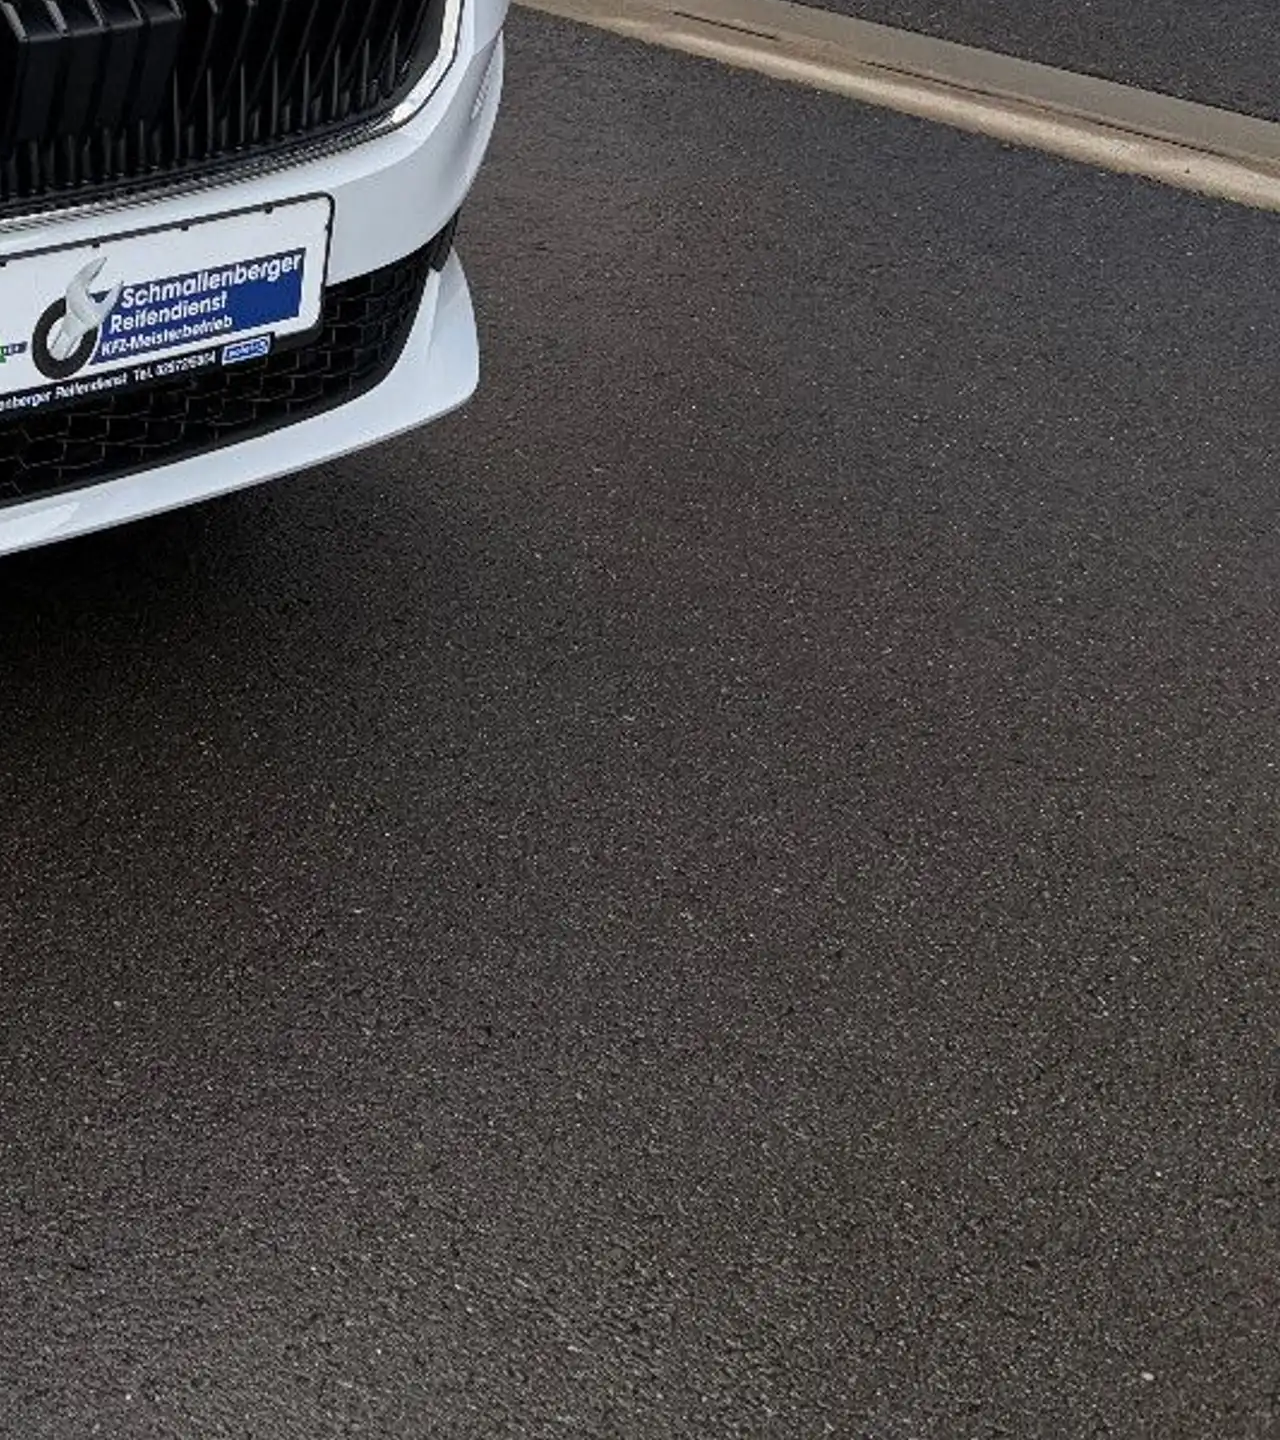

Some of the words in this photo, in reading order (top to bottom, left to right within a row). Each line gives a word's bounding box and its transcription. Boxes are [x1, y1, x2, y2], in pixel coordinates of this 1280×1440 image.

[120, 254, 302, 309] Schmallenberger
[100, 315, 234, 357] KFZ-Meisterbetrieb
[108, 290, 228, 336] Reifendienst
